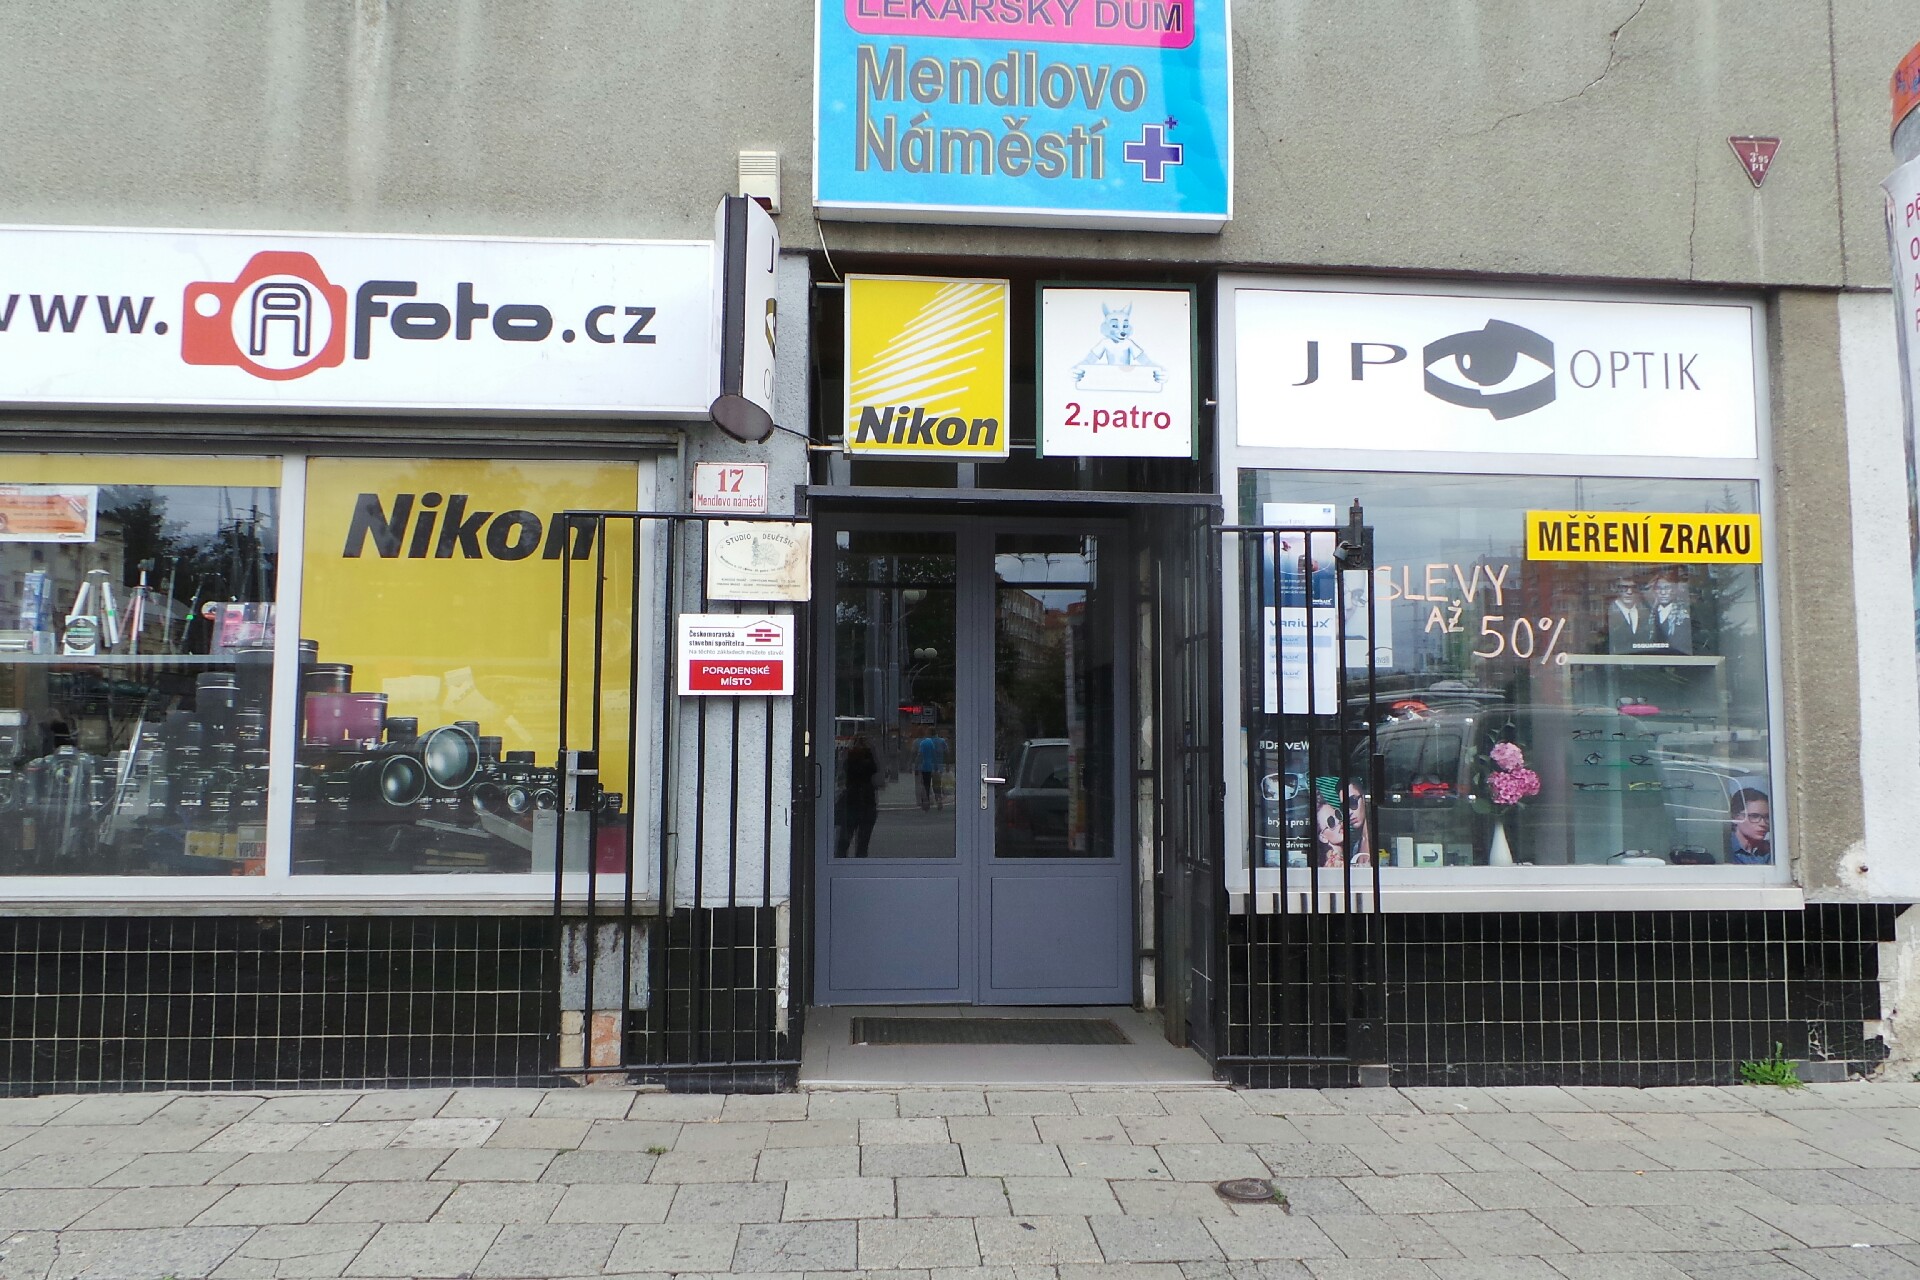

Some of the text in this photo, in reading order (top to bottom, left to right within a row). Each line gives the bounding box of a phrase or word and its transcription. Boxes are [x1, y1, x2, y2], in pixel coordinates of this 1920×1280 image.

[856, 45, 1147, 112] Mendlovo
[855, 111, 1110, 180] Náměstí
[1569, 349, 1701, 391] OPTIK
[855, 404, 999, 446] Nikon
[698, 494, 764, 507] Mendlovo náměstí
[717, 469, 744, 492] 17
[342, 491, 598, 561] Nikon
[725, 533, 752, 546] STUDIO
[1538, 514, 1750, 555] MĚŘENÍ ZRAKU
[1374, 563, 1509, 606] SLEVY
[1424, 599, 1569, 666] AŽ 50%
[702, 665, 770, 675] PORADENSKÉ
[720, 676, 752, 686] MÍSTO
